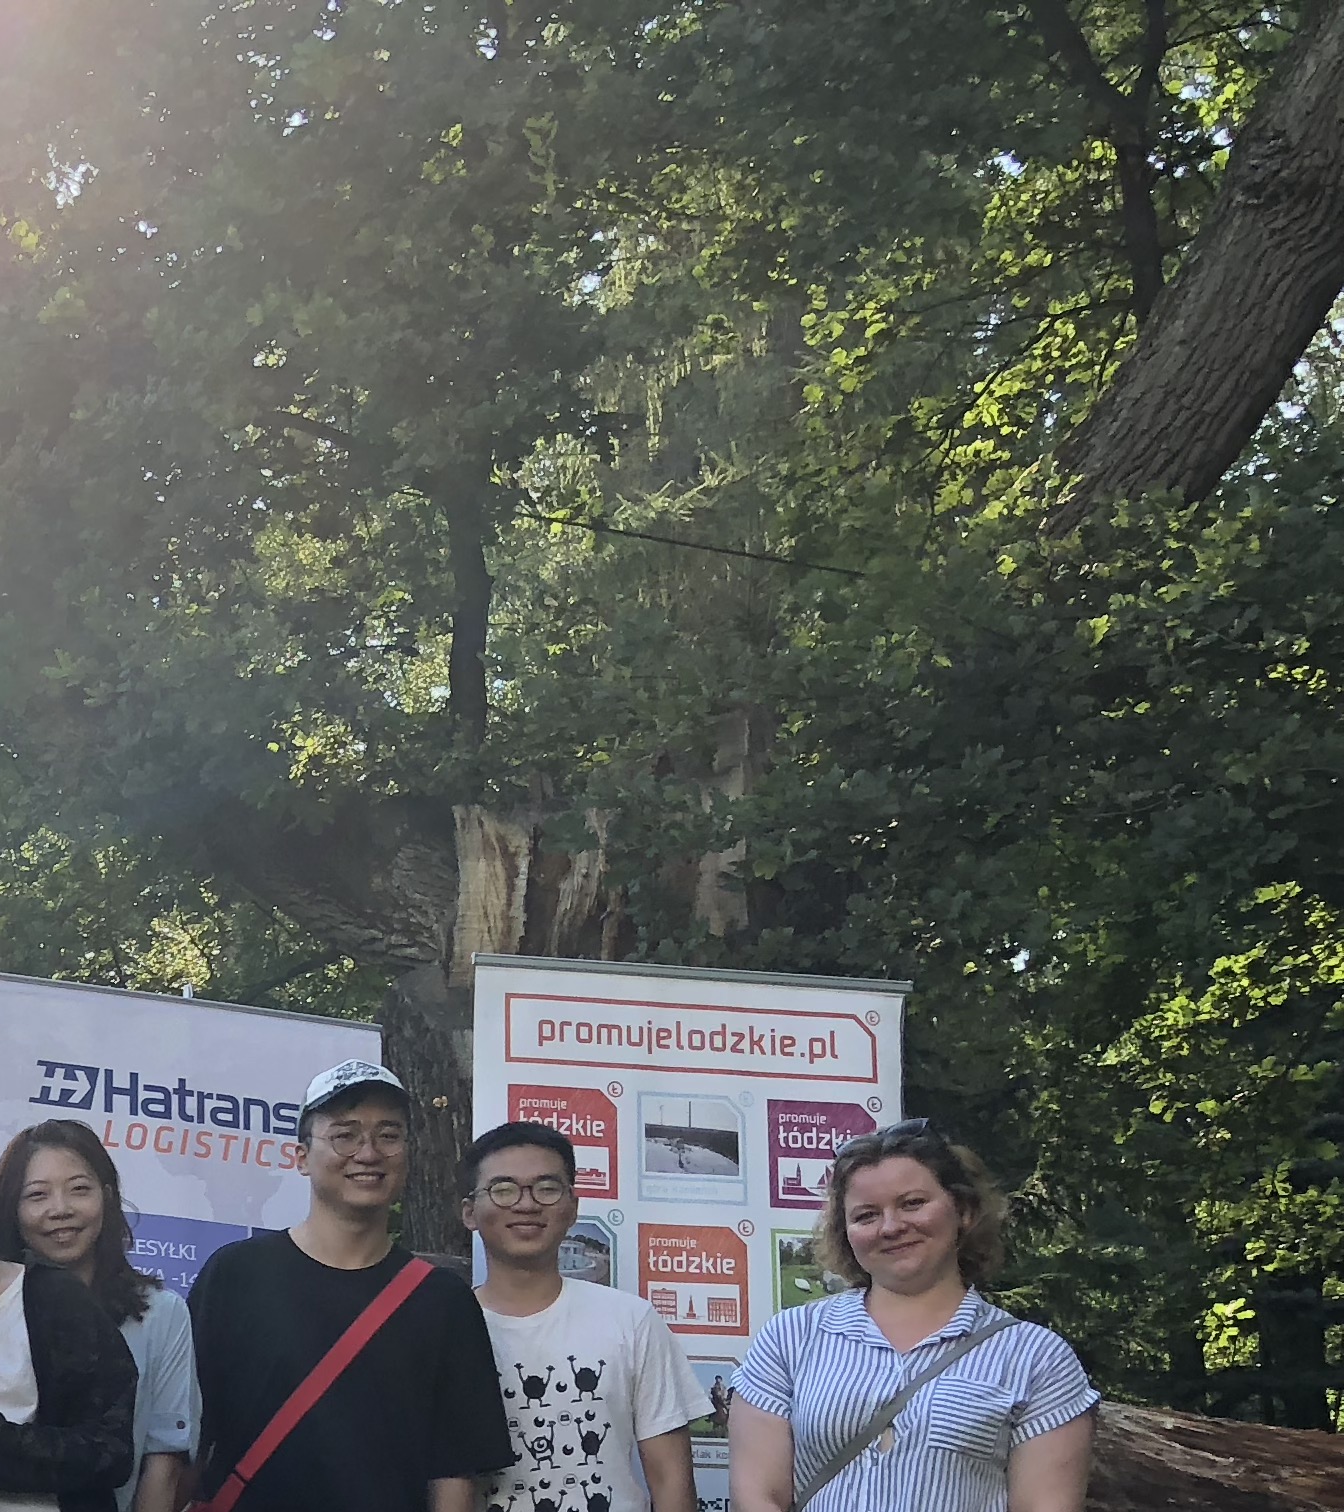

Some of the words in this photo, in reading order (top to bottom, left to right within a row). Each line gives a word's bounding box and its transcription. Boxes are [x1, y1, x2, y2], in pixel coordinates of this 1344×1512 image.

[537, 1019, 840, 1065] promujelodzkie.pl
[103, 1068, 301, 1137] Hatrans
[519, 1097, 567, 1111] promuje
[778, 1112, 827, 1126] promuje
[102, 1119, 299, 1170] LOGISTICS
[778, 1125, 859, 1150] łódzki
[127, 1238, 197, 1260] ESYŁKI
[648, 1236, 697, 1249] promuje
[648, 1249, 736, 1275] łódzkie
